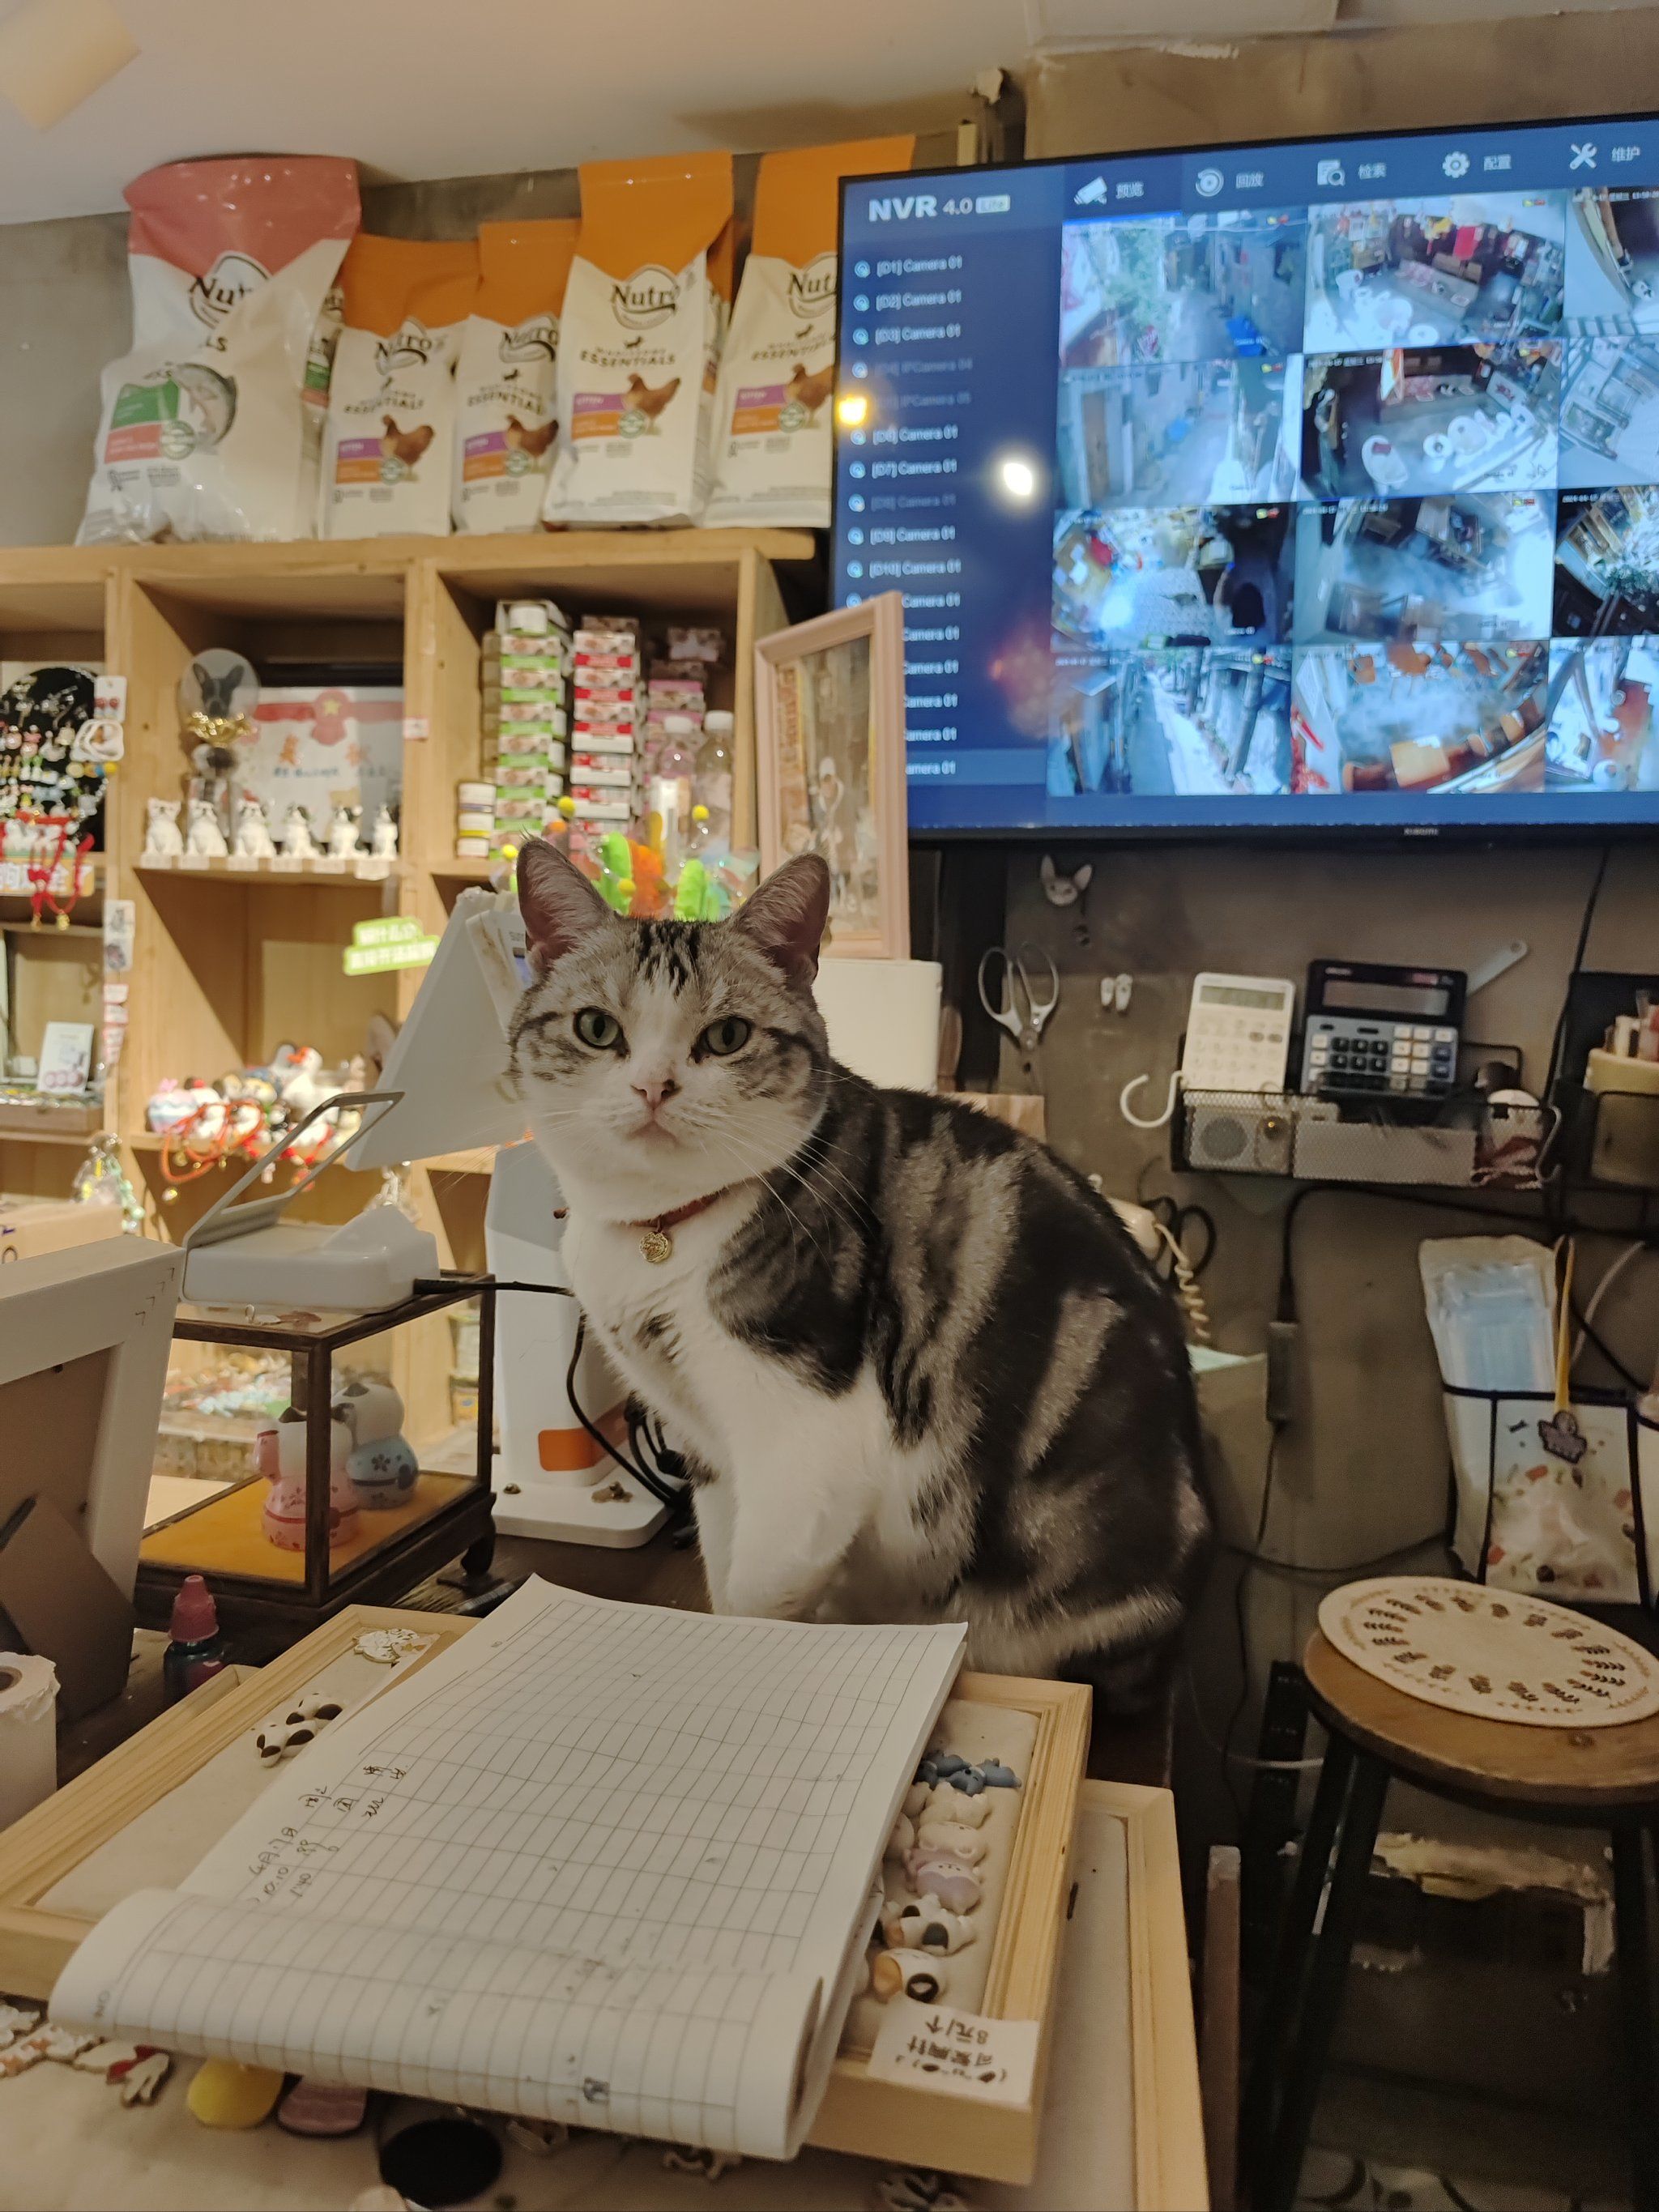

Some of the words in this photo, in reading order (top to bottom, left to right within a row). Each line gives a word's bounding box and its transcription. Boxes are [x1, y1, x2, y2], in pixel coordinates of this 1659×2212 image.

[1483, 153, 1512, 172] 配置
[868, 194, 937, 222] NVR
[942, 197, 974, 215] 4.0
[903, 258, 947, 273] Camera
[902, 292, 946, 307] Camera
[902, 326, 945, 341] Camera
[899, 427, 943, 442] Camera
[898, 460, 940, 475] Camera
[897, 526, 940, 542] Camera
[902, 559, 946, 575] Camera
[902, 593, 945, 608] Camera
[904, 727, 941, 741] amera
[906, 761, 940, 775] amera
[924, 2014, 990, 2045] 8元/个
